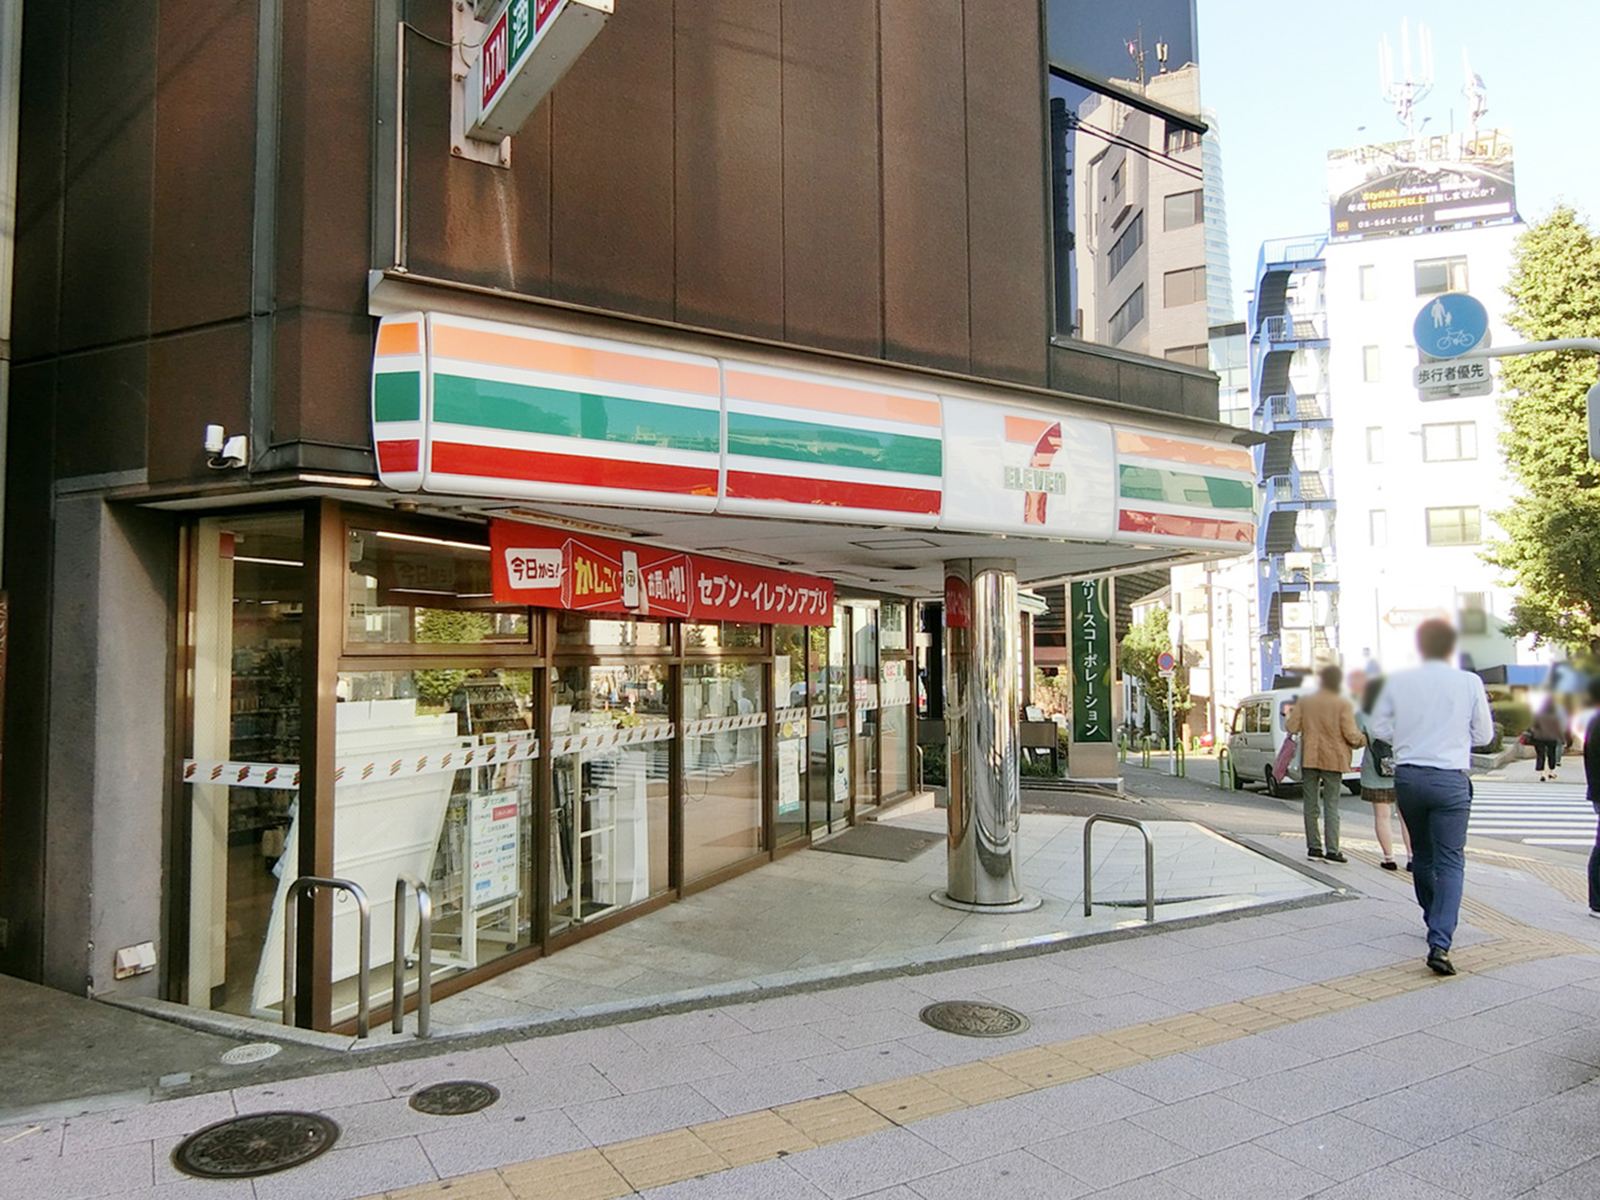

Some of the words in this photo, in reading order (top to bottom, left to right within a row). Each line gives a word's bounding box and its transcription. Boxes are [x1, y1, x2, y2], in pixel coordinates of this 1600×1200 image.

[483, 26, 506, 98] ATM
[1418, 363, 1484, 384] 歩行者優先
[510, 556, 560, 584] 今日から!
